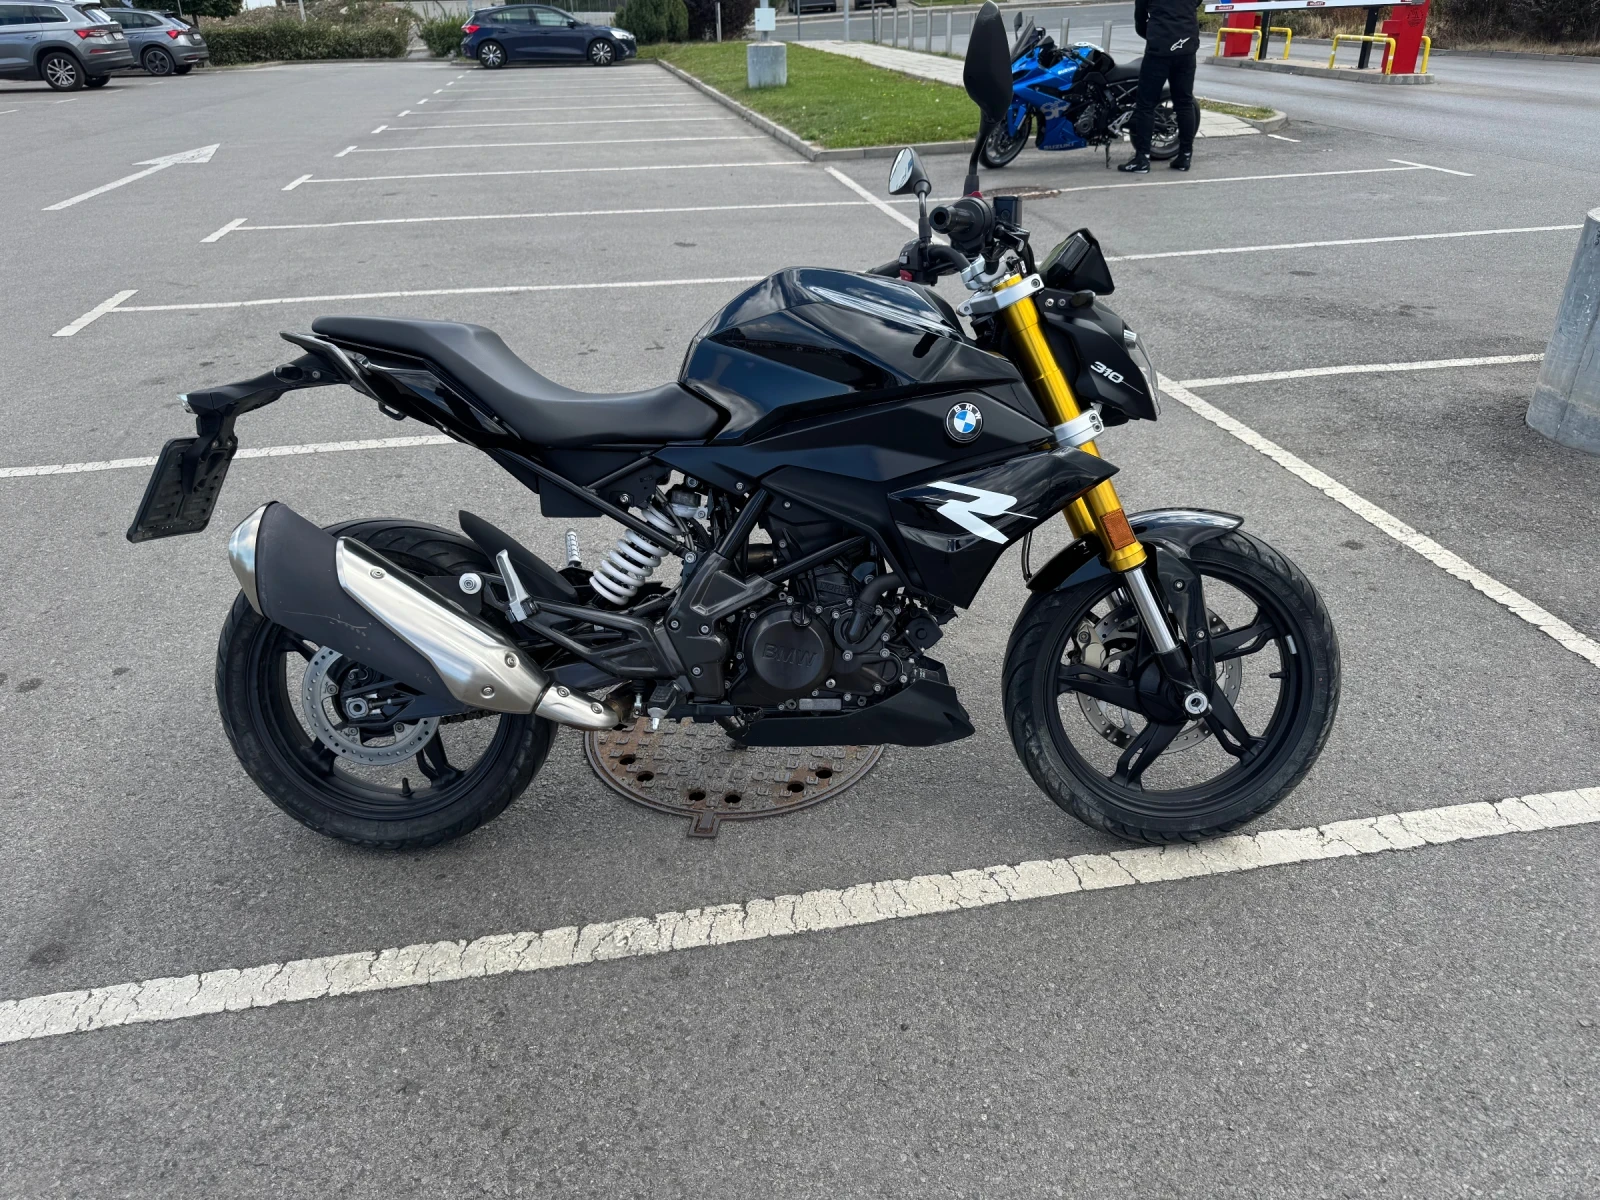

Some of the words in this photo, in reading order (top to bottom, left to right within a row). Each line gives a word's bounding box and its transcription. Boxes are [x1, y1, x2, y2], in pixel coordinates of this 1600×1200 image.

[1090, 361, 1124, 383] 310
[953, 403, 982, 420] BMW
[762, 643, 818, 668] BMW
